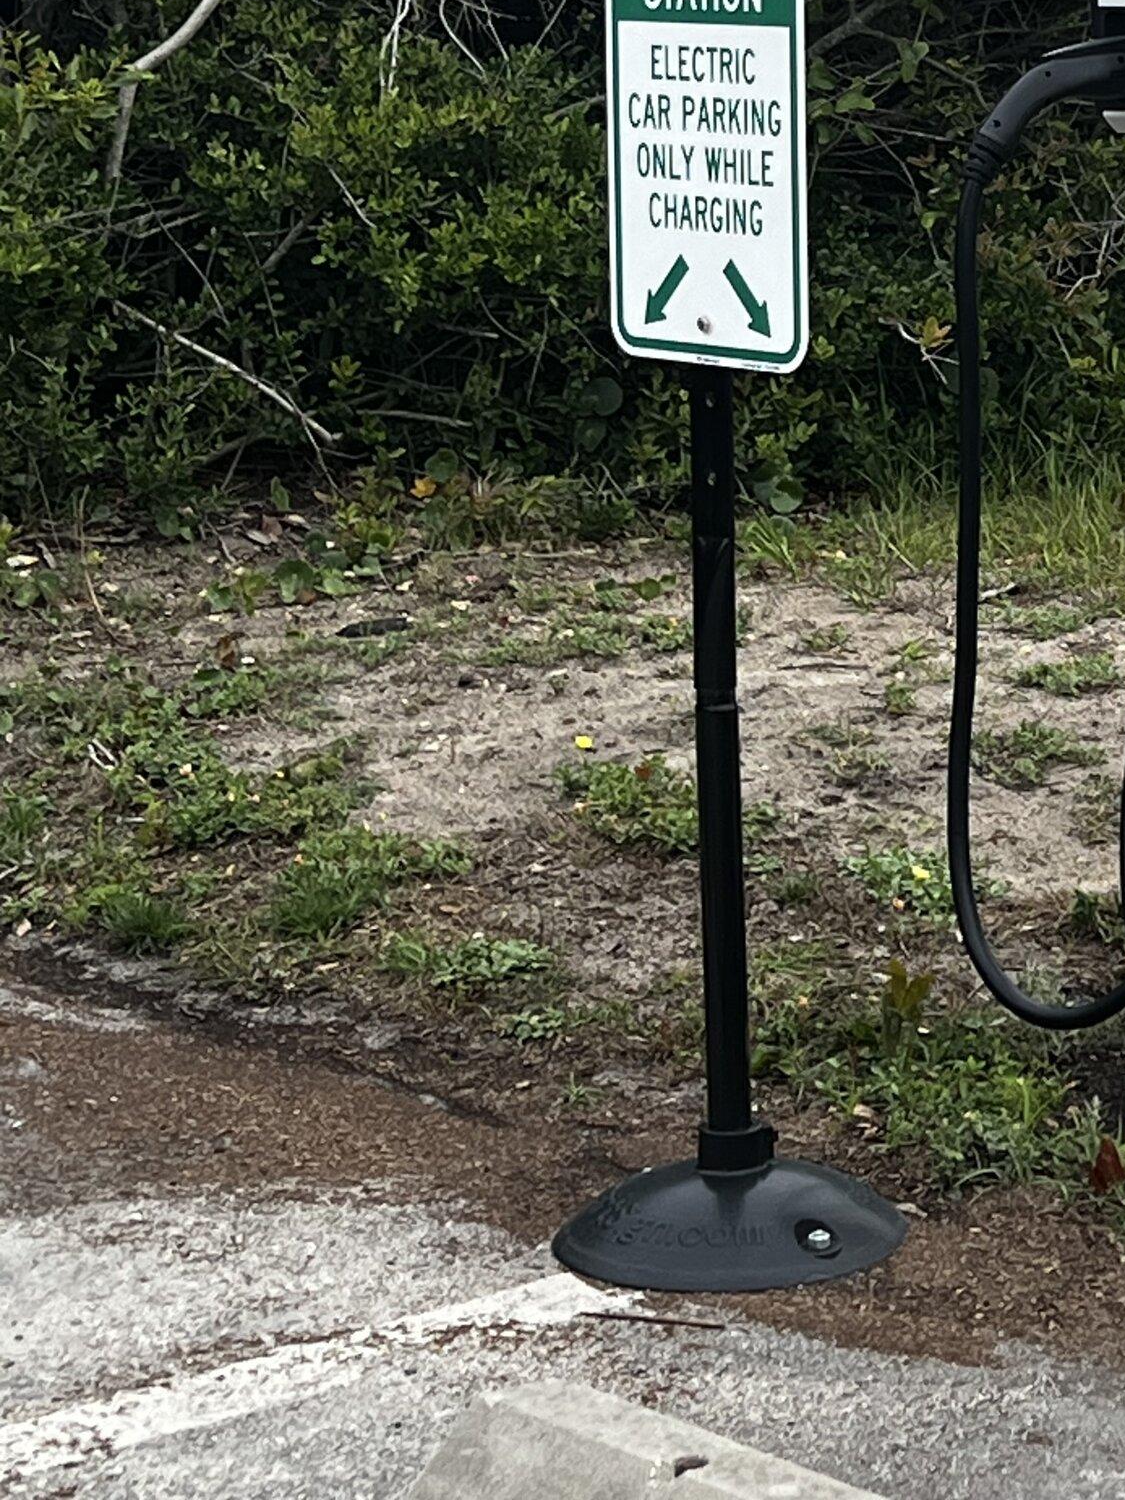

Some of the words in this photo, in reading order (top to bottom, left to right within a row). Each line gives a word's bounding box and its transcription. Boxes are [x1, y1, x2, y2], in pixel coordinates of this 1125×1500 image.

[651, 44, 756, 85] ELECTRIC
[628, 92, 671, 131] CAR
[681, 95, 782, 137] PARKING
[637, 142, 695, 182] ONLY
[705, 146, 774, 187] WHILE
[649, 192, 763, 236] CHARGING
